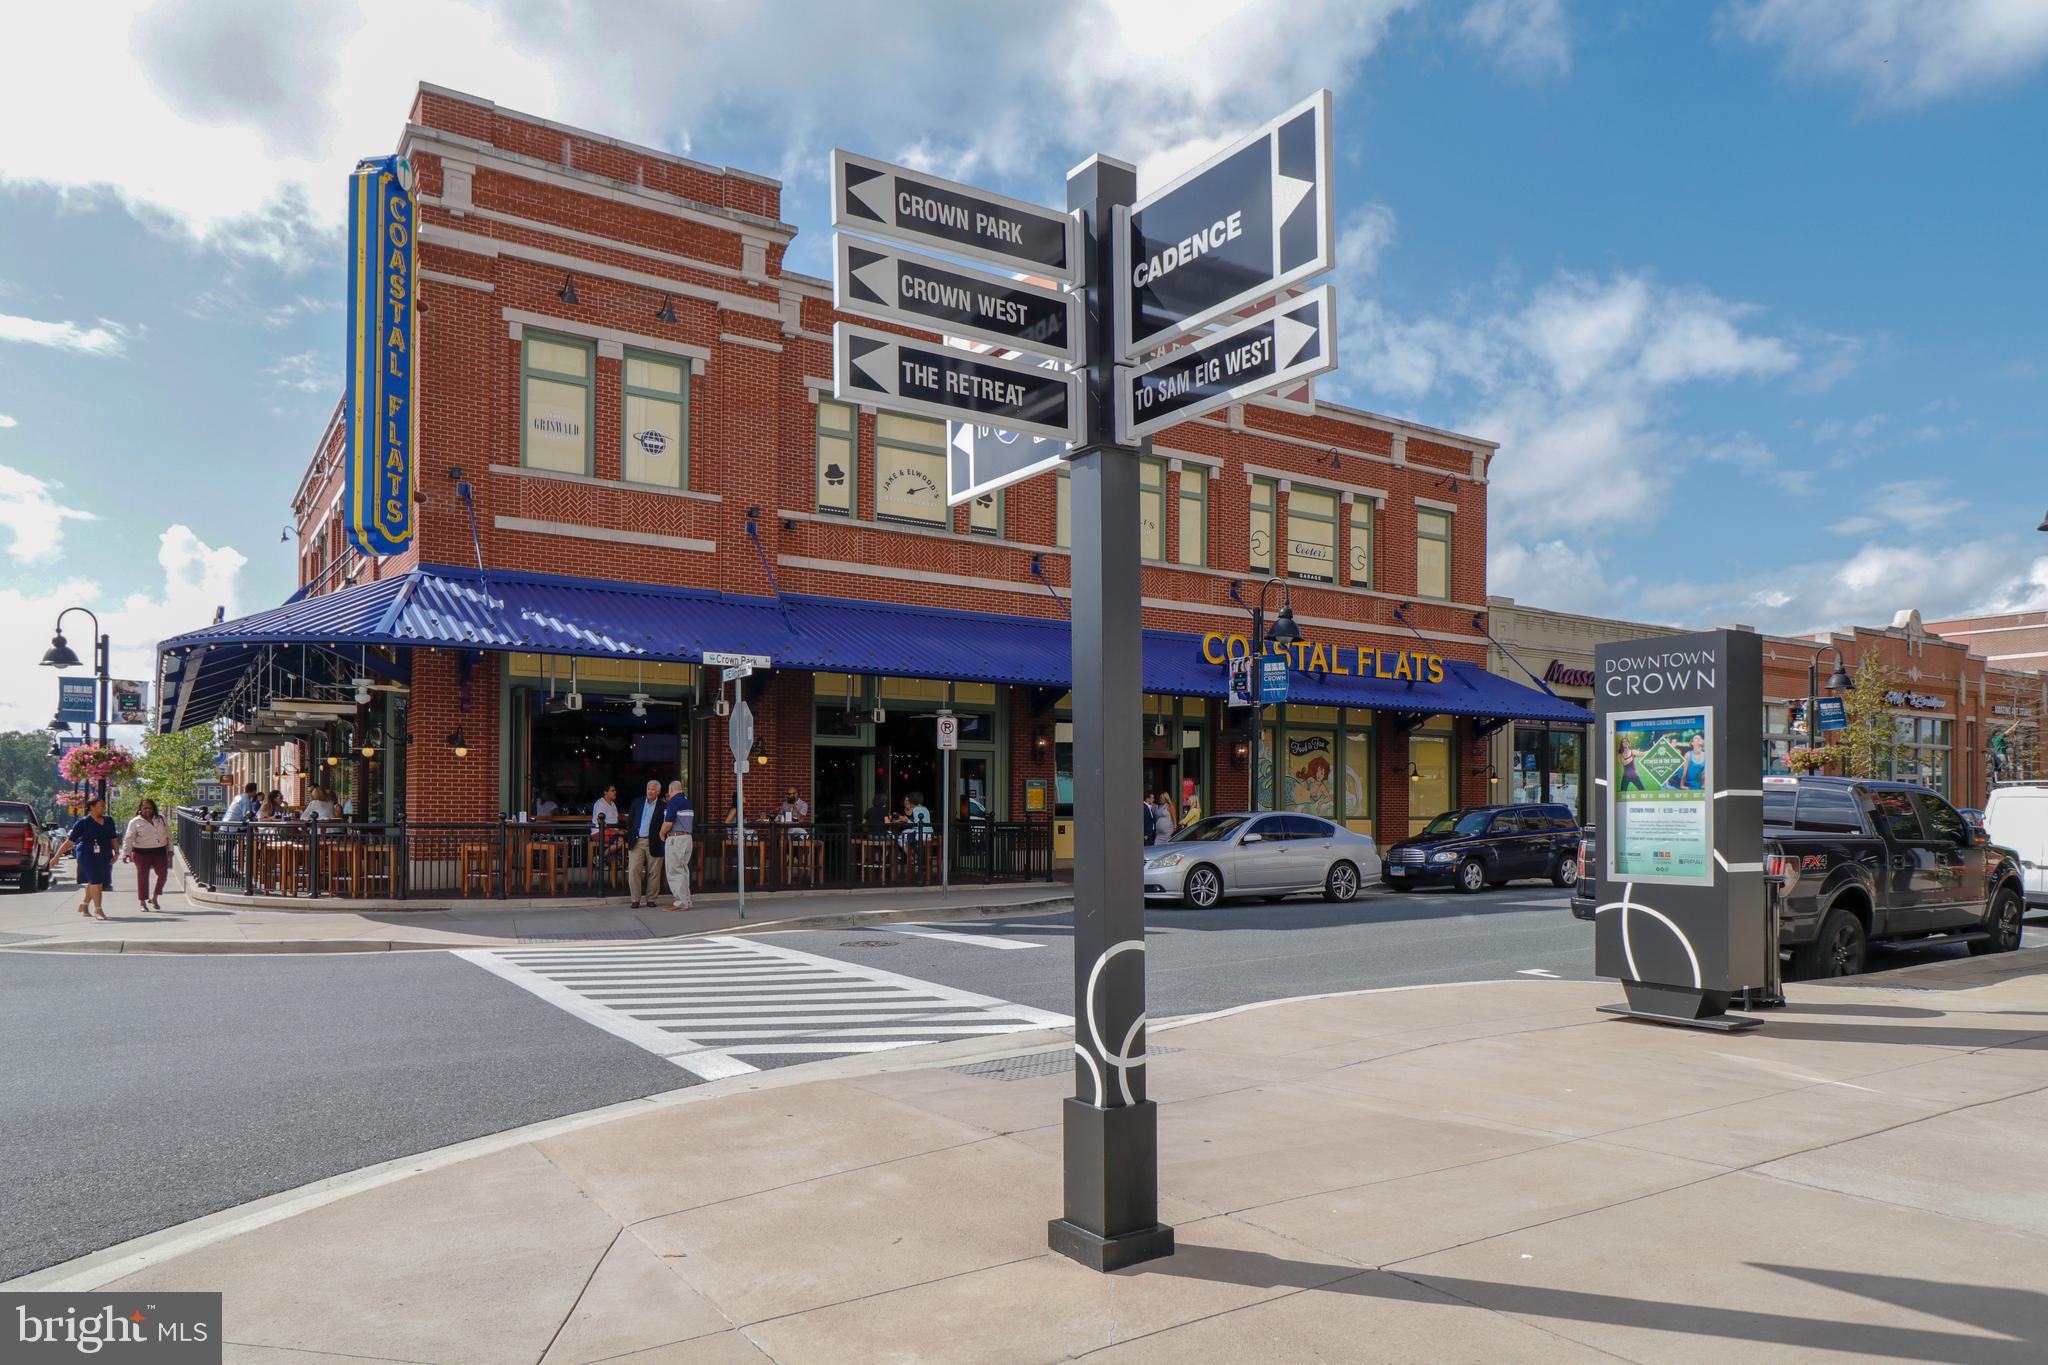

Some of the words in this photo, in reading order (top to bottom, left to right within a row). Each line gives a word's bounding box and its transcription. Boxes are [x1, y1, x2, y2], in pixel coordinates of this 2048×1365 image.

[898, 192, 969, 231] CROWN
[976, 213, 1023, 245] PARK
[1133, 210, 1242, 288] CADENCE
[389, 196, 409, 377] COASTAL
[901, 274, 971, 312] CROWN
[977, 293, 1028, 325] WEST
[902, 361, 938, 389] THE
[945, 370, 1025, 407] RETREAT
[1135, 387, 1153, 410] TO
[1158, 370, 1190, 402] SAM
[1195, 358, 1220, 388] EIG
[1224, 336, 1272, 375] WEST
[534, 418, 579, 436] GRISWALD
[386, 394, 404, 523] FLATS
[883, 472, 898, 491] JAKE
[906, 468, 940, 499] ELWOOD'S
[1295, 543, 1327, 559] Cooter's
[1300, 573, 1321, 581] GARAGE
[716, 654, 738, 666] Crown
[741, 656, 757, 667] Park
[1357, 646, 1444, 684] FLATS
[1605, 649, 1715, 673] DOWNTOWN
[1605, 668, 1715, 697] CROWN
[1802, 855, 1828, 868] FX4
